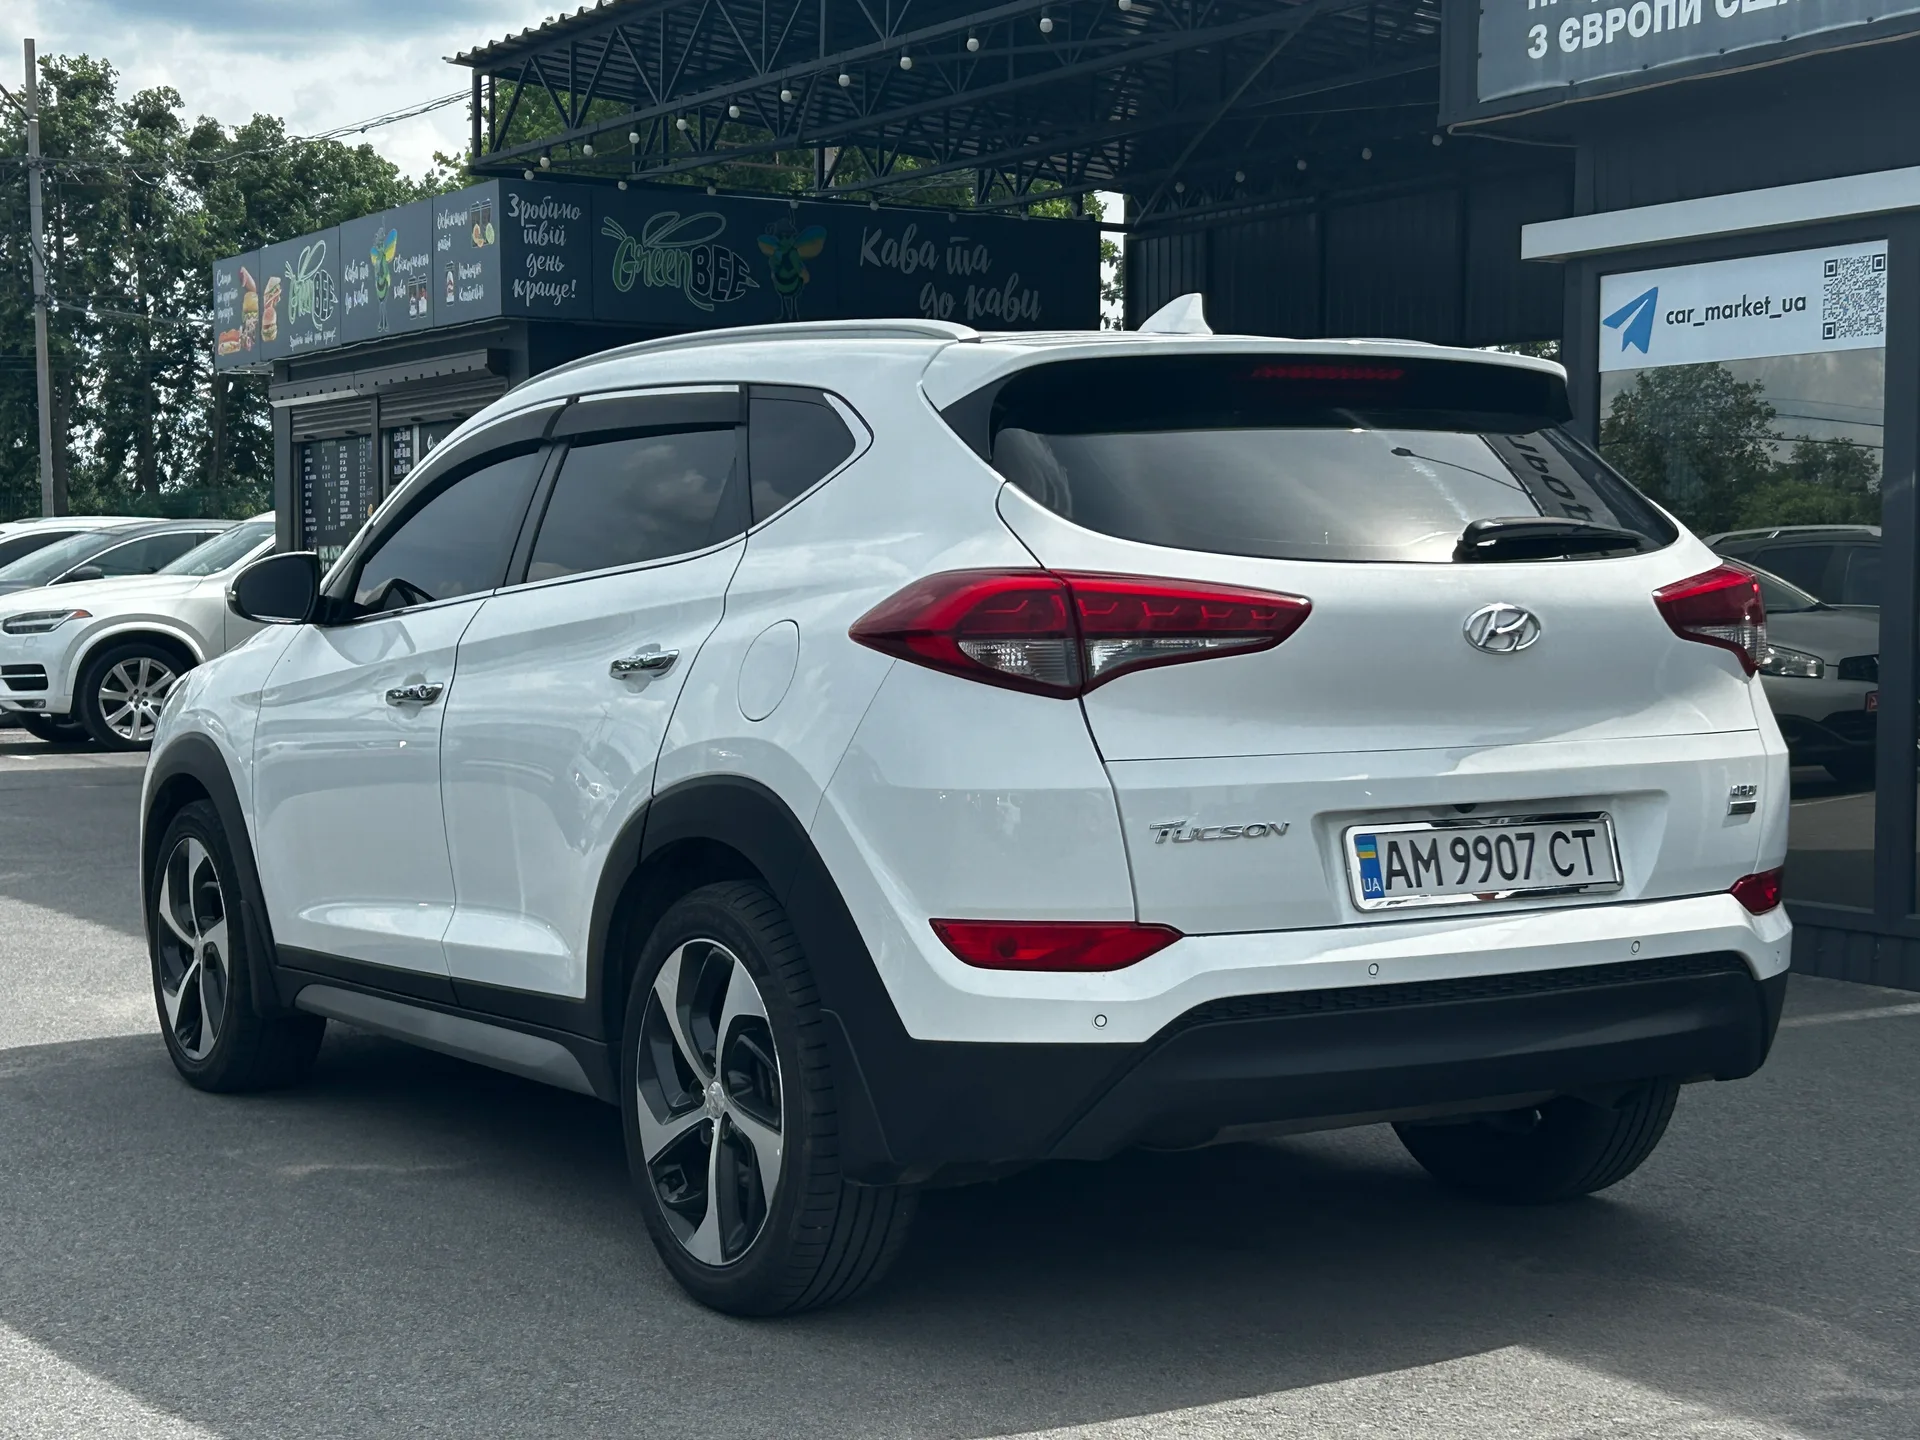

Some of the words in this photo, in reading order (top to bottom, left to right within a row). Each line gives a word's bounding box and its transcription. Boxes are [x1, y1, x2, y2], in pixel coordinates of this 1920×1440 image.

[1527, 23, 1548, 59] З
[1558, 0, 1702, 53] ЄВРОПИ
[508, 193, 581, 227] Зробимо
[523, 220, 567, 247] твій
[860, 223, 939, 275] Кава
[946, 236, 993, 276] та
[526, 252, 565, 278] день
[512, 279, 577, 307] краще!
[919, 281, 956, 319] до
[964, 272, 1042, 323] кави
[1665, 294, 1807, 327] car_market_ua
[1149, 817, 1291, 845] TUCSON
[1385, 837, 1444, 890] AM
[1449, 831, 1535, 885] 9907
[1549, 828, 1596, 877] CT
[1362, 876, 1382, 893] UA
